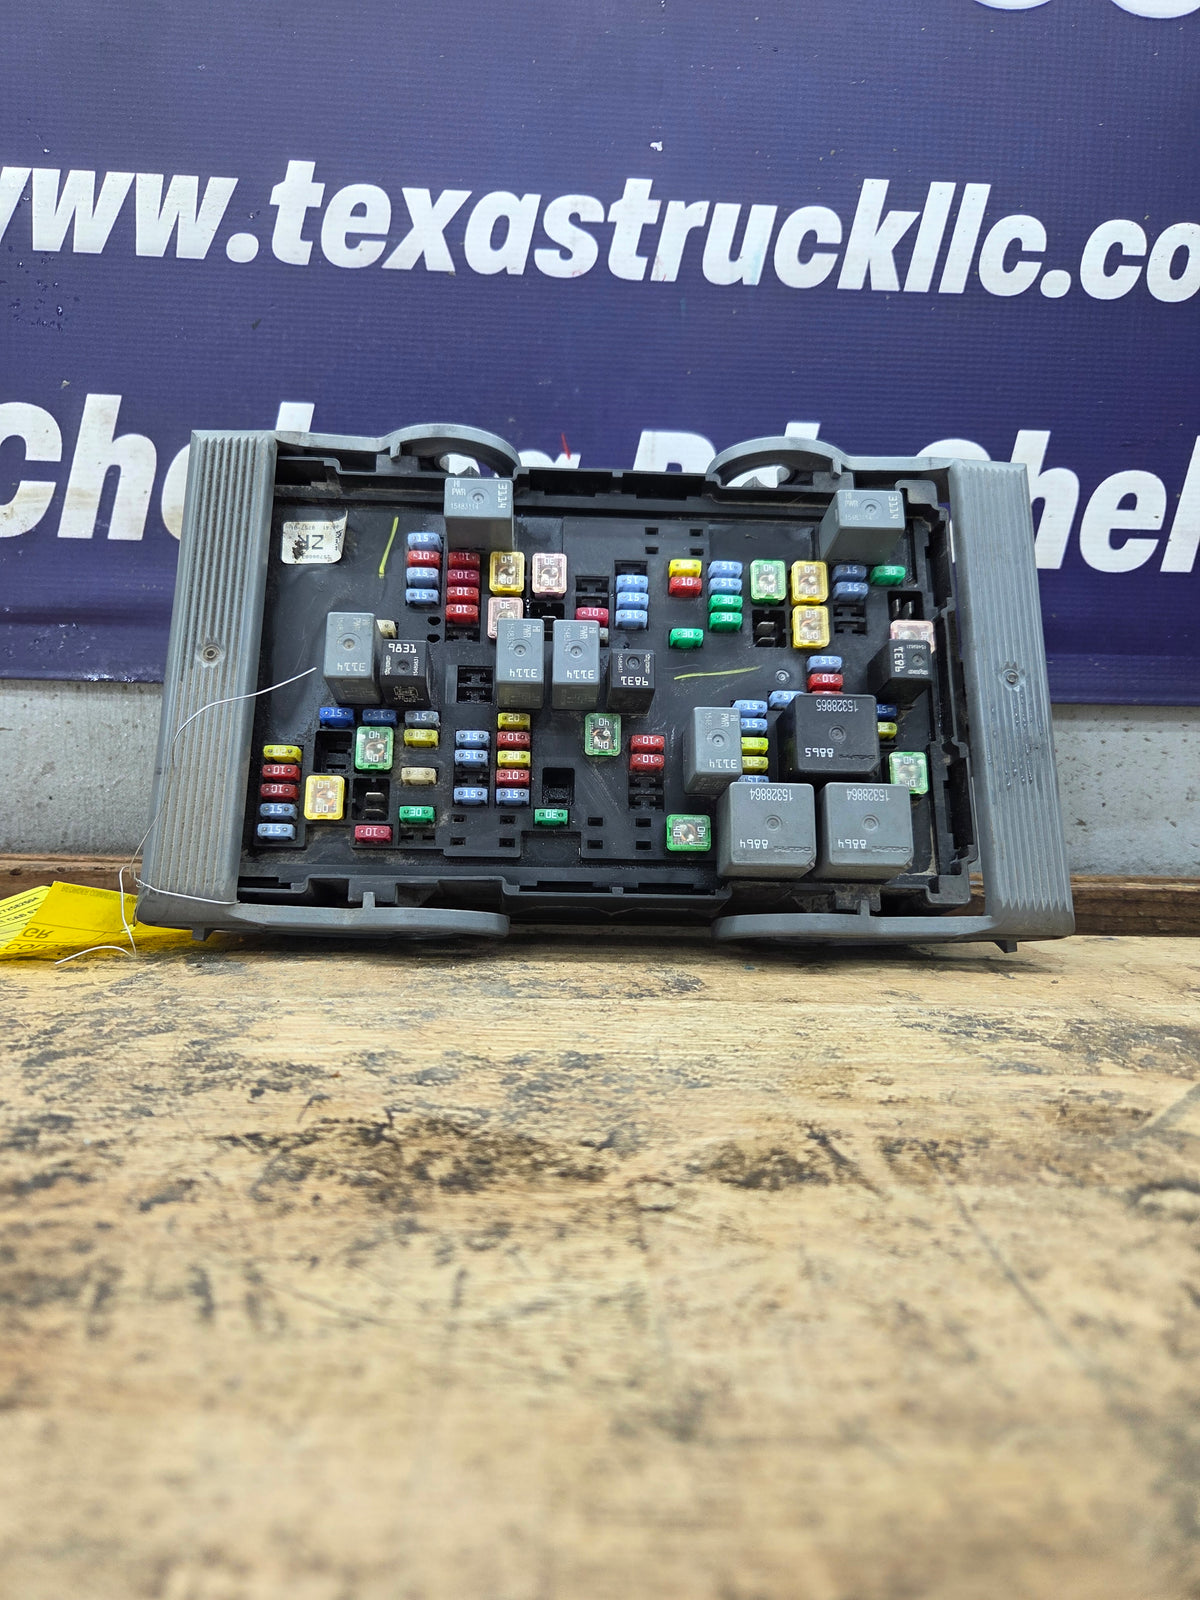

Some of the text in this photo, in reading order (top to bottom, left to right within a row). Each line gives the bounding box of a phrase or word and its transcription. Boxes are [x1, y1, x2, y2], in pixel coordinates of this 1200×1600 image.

[418, 551, 429, 559] 10
[682, 578, 692, 586] 10
[457, 587, 467, 595] 10
[722, 596, 732, 604] 30
[456, 605, 467, 613] 10
[683, 630, 693, 638] 30
[389, 643, 417, 653] 9831
[821, 657, 832, 665] 15
[894, 647, 903, 672] 9831
[338, 663, 365, 671] 3114
[510, 669, 537, 677] 3114
[567, 670, 594, 678] 3114
[621, 677, 648, 685] 9831
[747, 702, 758, 710] 15
[816, 700, 858, 711] 15328865
[598, 718, 609, 726] 40
[746, 720, 757, 728] 15
[643, 736, 653, 744] 10
[508, 752, 520, 760] 20
[805, 748, 834, 757] 8865
[643, 755, 653, 763] 10
[709, 759, 737, 768] 3114
[271, 785, 283, 793] 10
[750, 788, 793, 800] 15328864
[847, 788, 890, 800] 15328864
[410, 808, 421, 816] 30
[546, 810, 556, 818] 30
[740, 839, 768, 849] 8864
[838, 839, 866, 849] 8864
